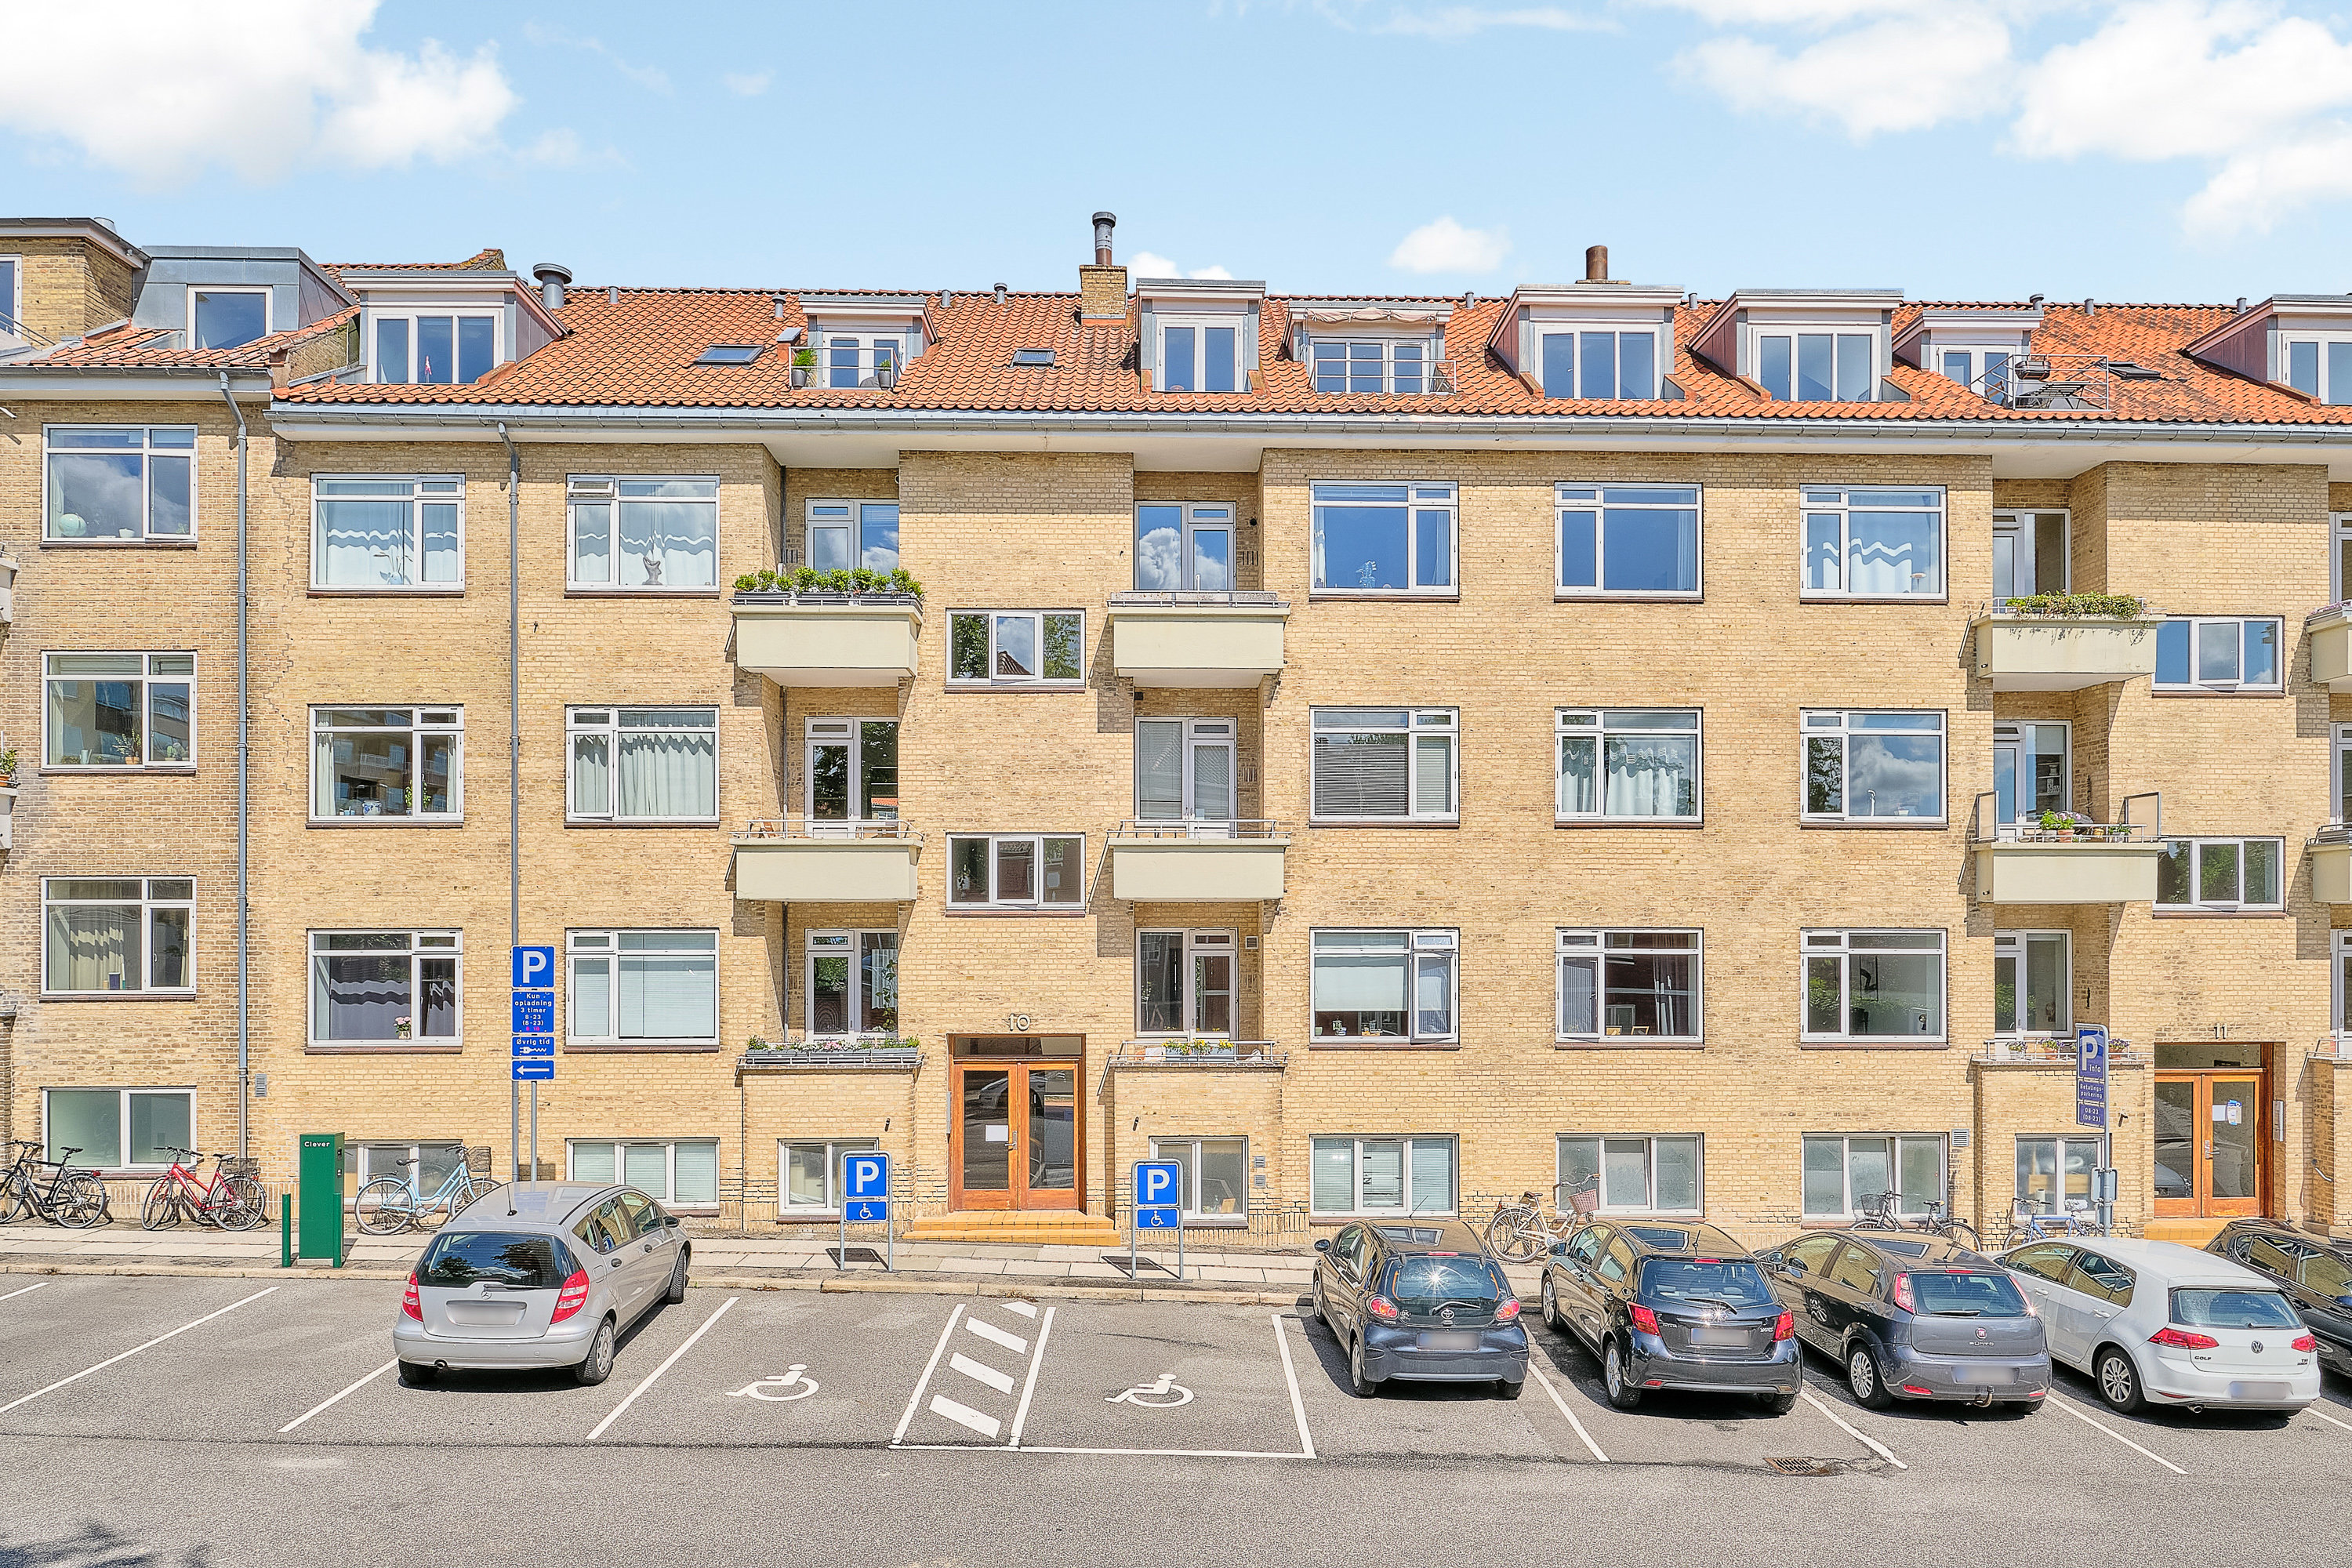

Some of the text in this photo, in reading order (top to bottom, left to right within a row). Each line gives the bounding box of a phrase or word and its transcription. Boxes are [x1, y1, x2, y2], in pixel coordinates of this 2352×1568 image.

[523, 950, 547, 984] P
[1007, 1013, 1032, 1031] 10
[2214, 1022, 2228, 1039] 11
[2082, 1035, 2099, 1071] P
[2089, 1063, 2101, 1073] info
[2080, 1091, 2103, 1099] parkering
[855, 1160, 880, 1193] P
[1147, 1168, 1171, 1201] P
